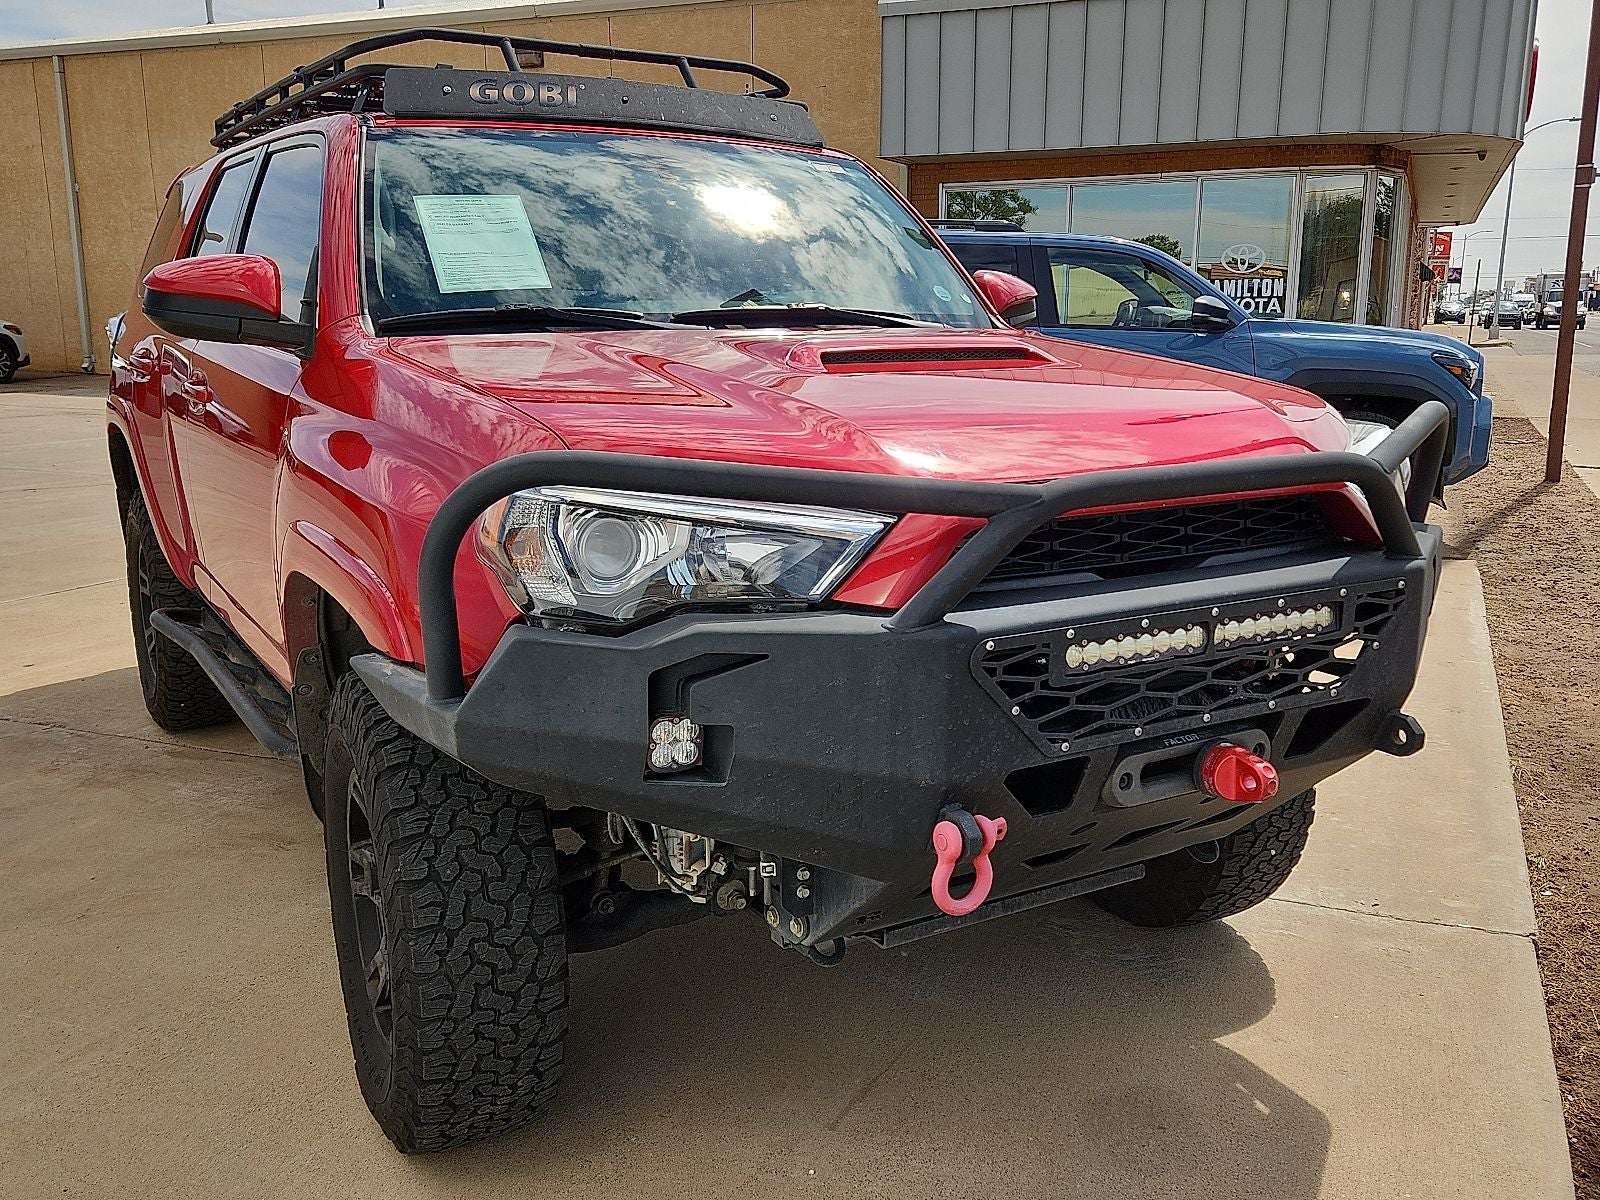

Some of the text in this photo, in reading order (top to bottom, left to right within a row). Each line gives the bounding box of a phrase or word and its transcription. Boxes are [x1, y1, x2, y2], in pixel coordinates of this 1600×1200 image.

[468, 78, 578, 109] GOBI
[1207, 278, 1284, 297] AMILTON
[1163, 733, 1200, 747] FACTOR
